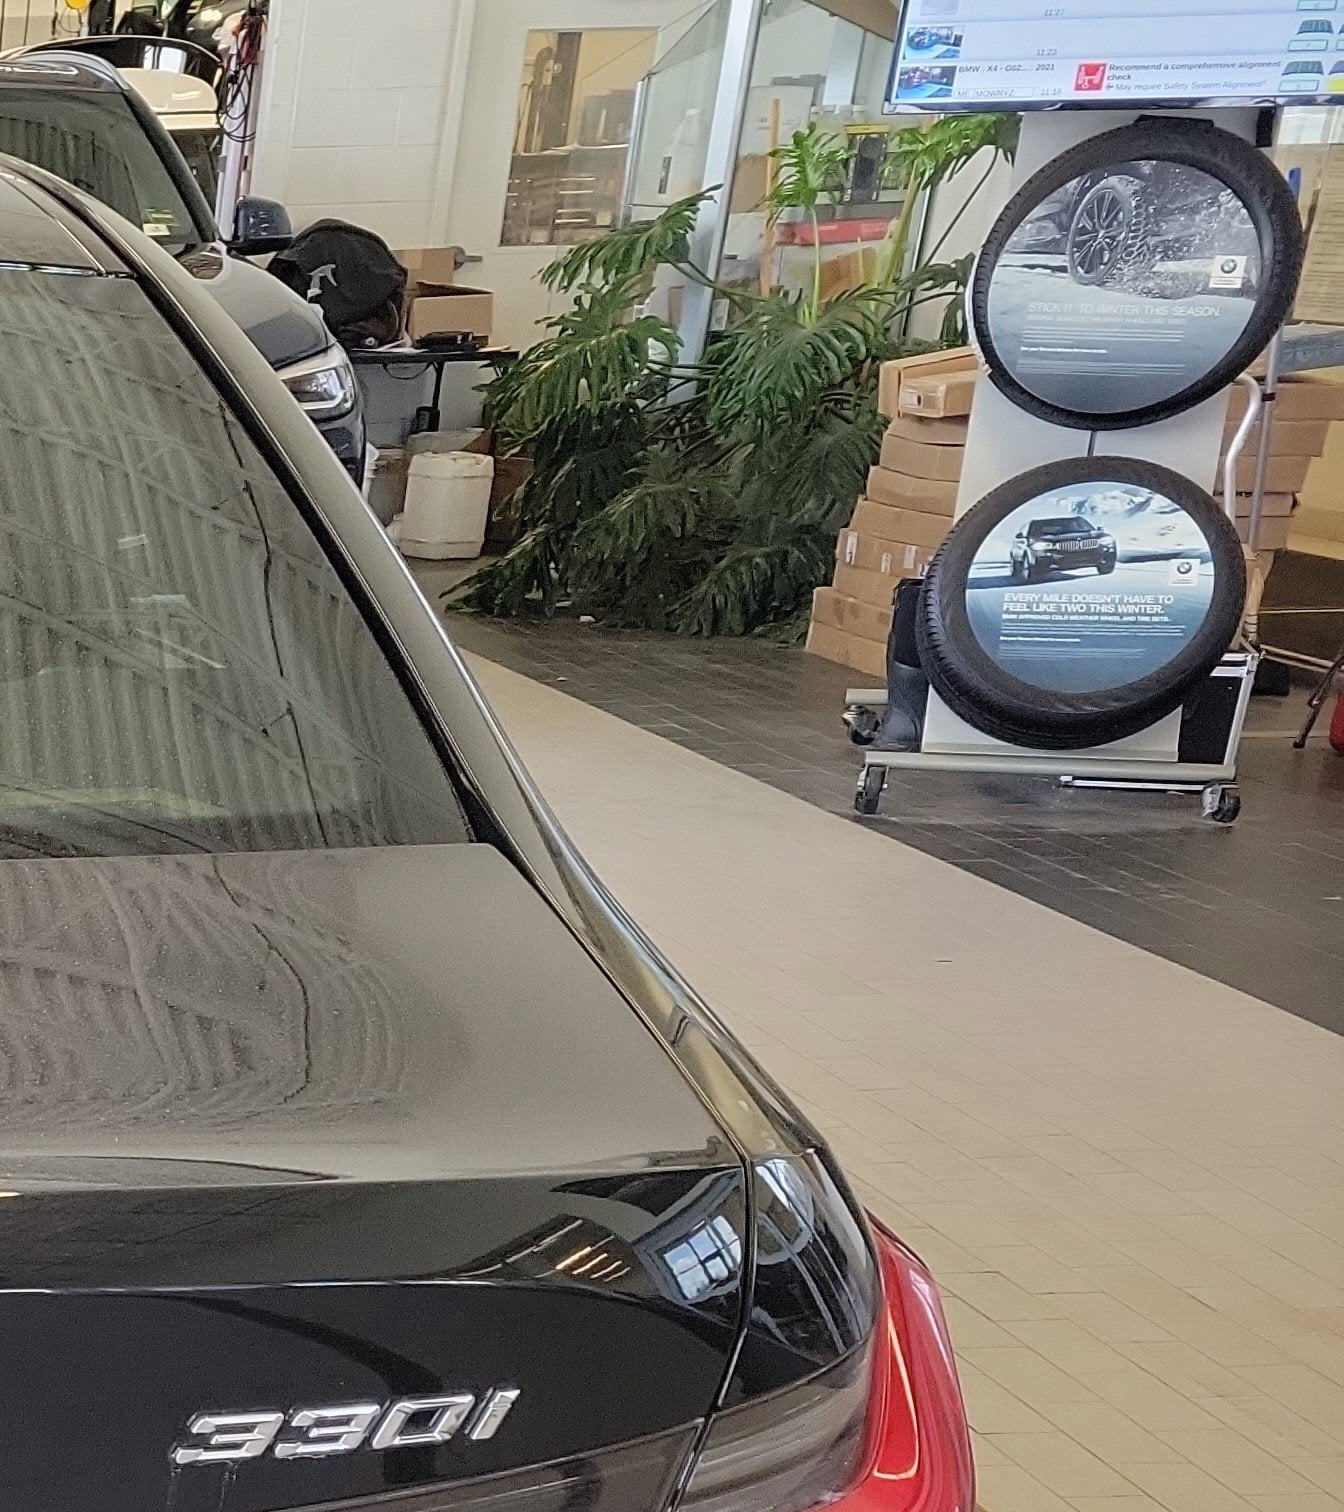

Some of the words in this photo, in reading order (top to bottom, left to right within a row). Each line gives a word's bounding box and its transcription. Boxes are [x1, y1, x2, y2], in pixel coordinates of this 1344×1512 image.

[1109, 63, 1162, 71] Recommend
[1171, 61, 1236, 71] comprehensive
[1238, 59, 1282, 70] alignment
[1107, 73, 1131, 81] check
[1097, 303, 1140, 315] WINTER
[1144, 305, 1169, 316] THIS
[1004, 593, 1041, 603] EVERY
[1045, 594, 1070, 603] MILE
[1071, 594, 1122, 603] DOESN'T
[1123, 595, 1155, 604] HAVE
[1157, 595, 1174, 604] TO
[1003, 602, 1031, 612] FEEL
[1032, 603, 1059, 612] LIKE
[1060, 603, 1087, 613] TWO
[1089, 604, 1115, 613] THIS
[1117, 604, 1165, 614] WINTER.
